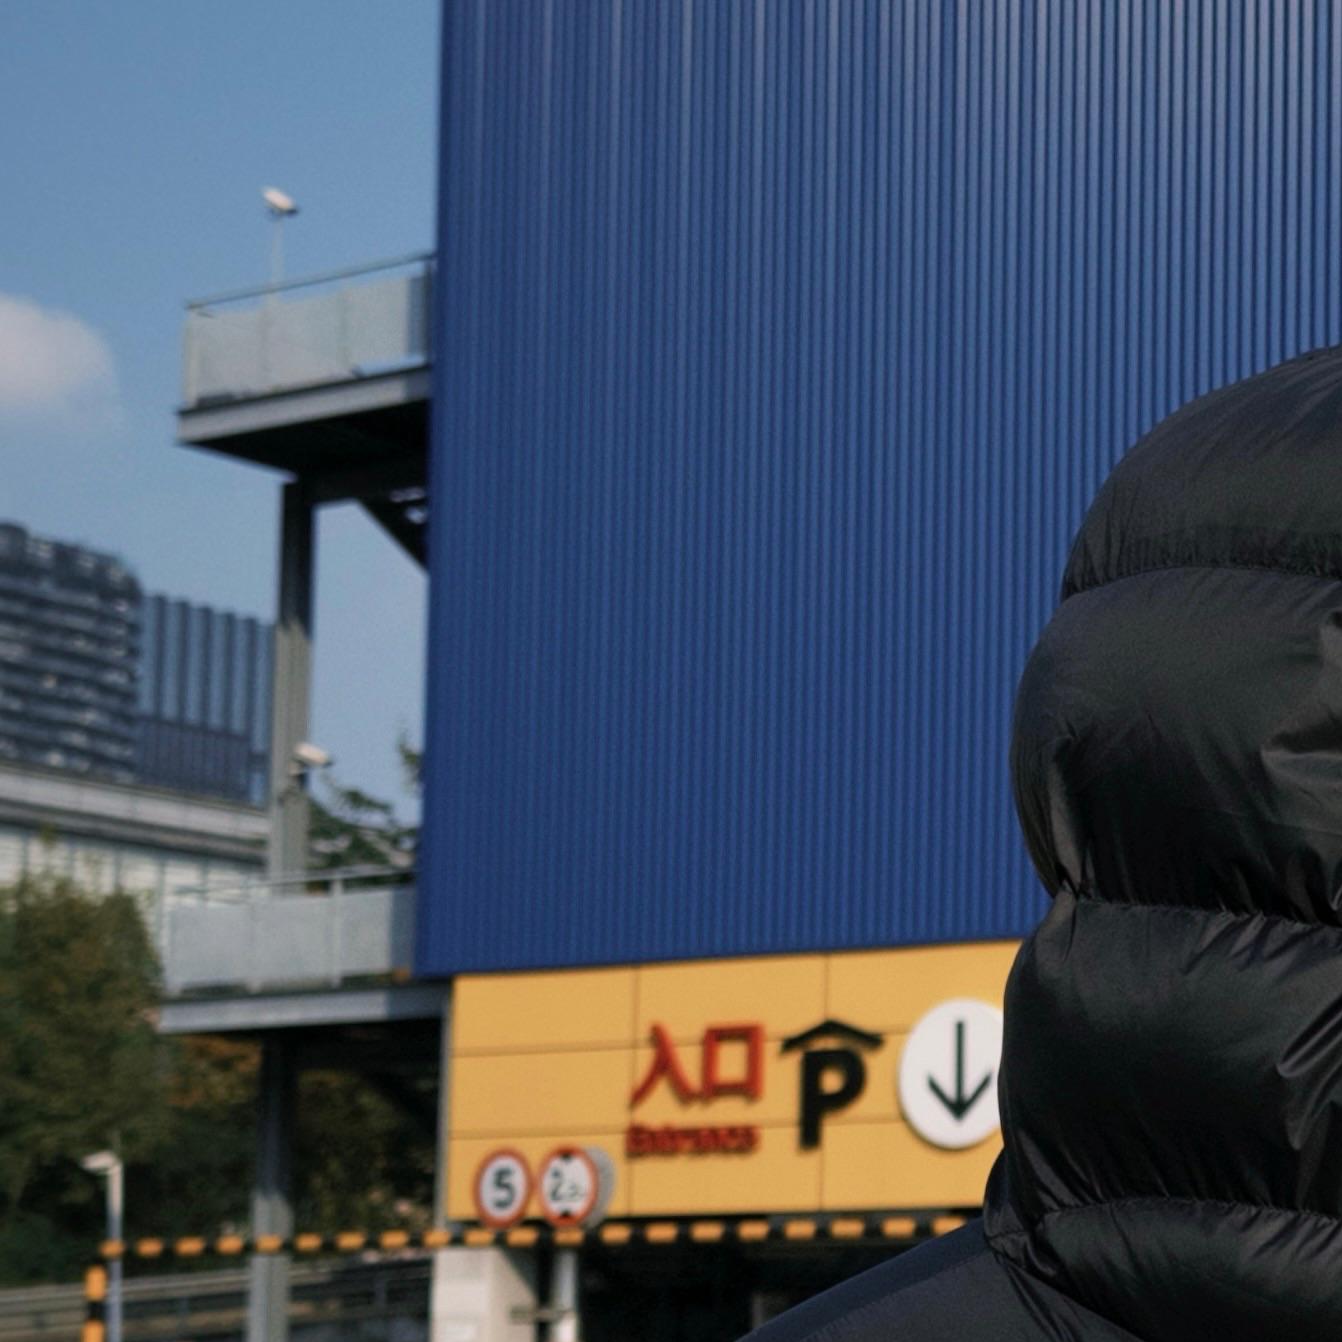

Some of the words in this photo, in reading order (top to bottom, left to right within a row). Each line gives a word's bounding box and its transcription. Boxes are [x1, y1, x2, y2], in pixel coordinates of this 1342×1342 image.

[630, 1022, 764, 1108] 入口
[800, 1049, 867, 1150] P
[493, 1167, 516, 1209] 5
